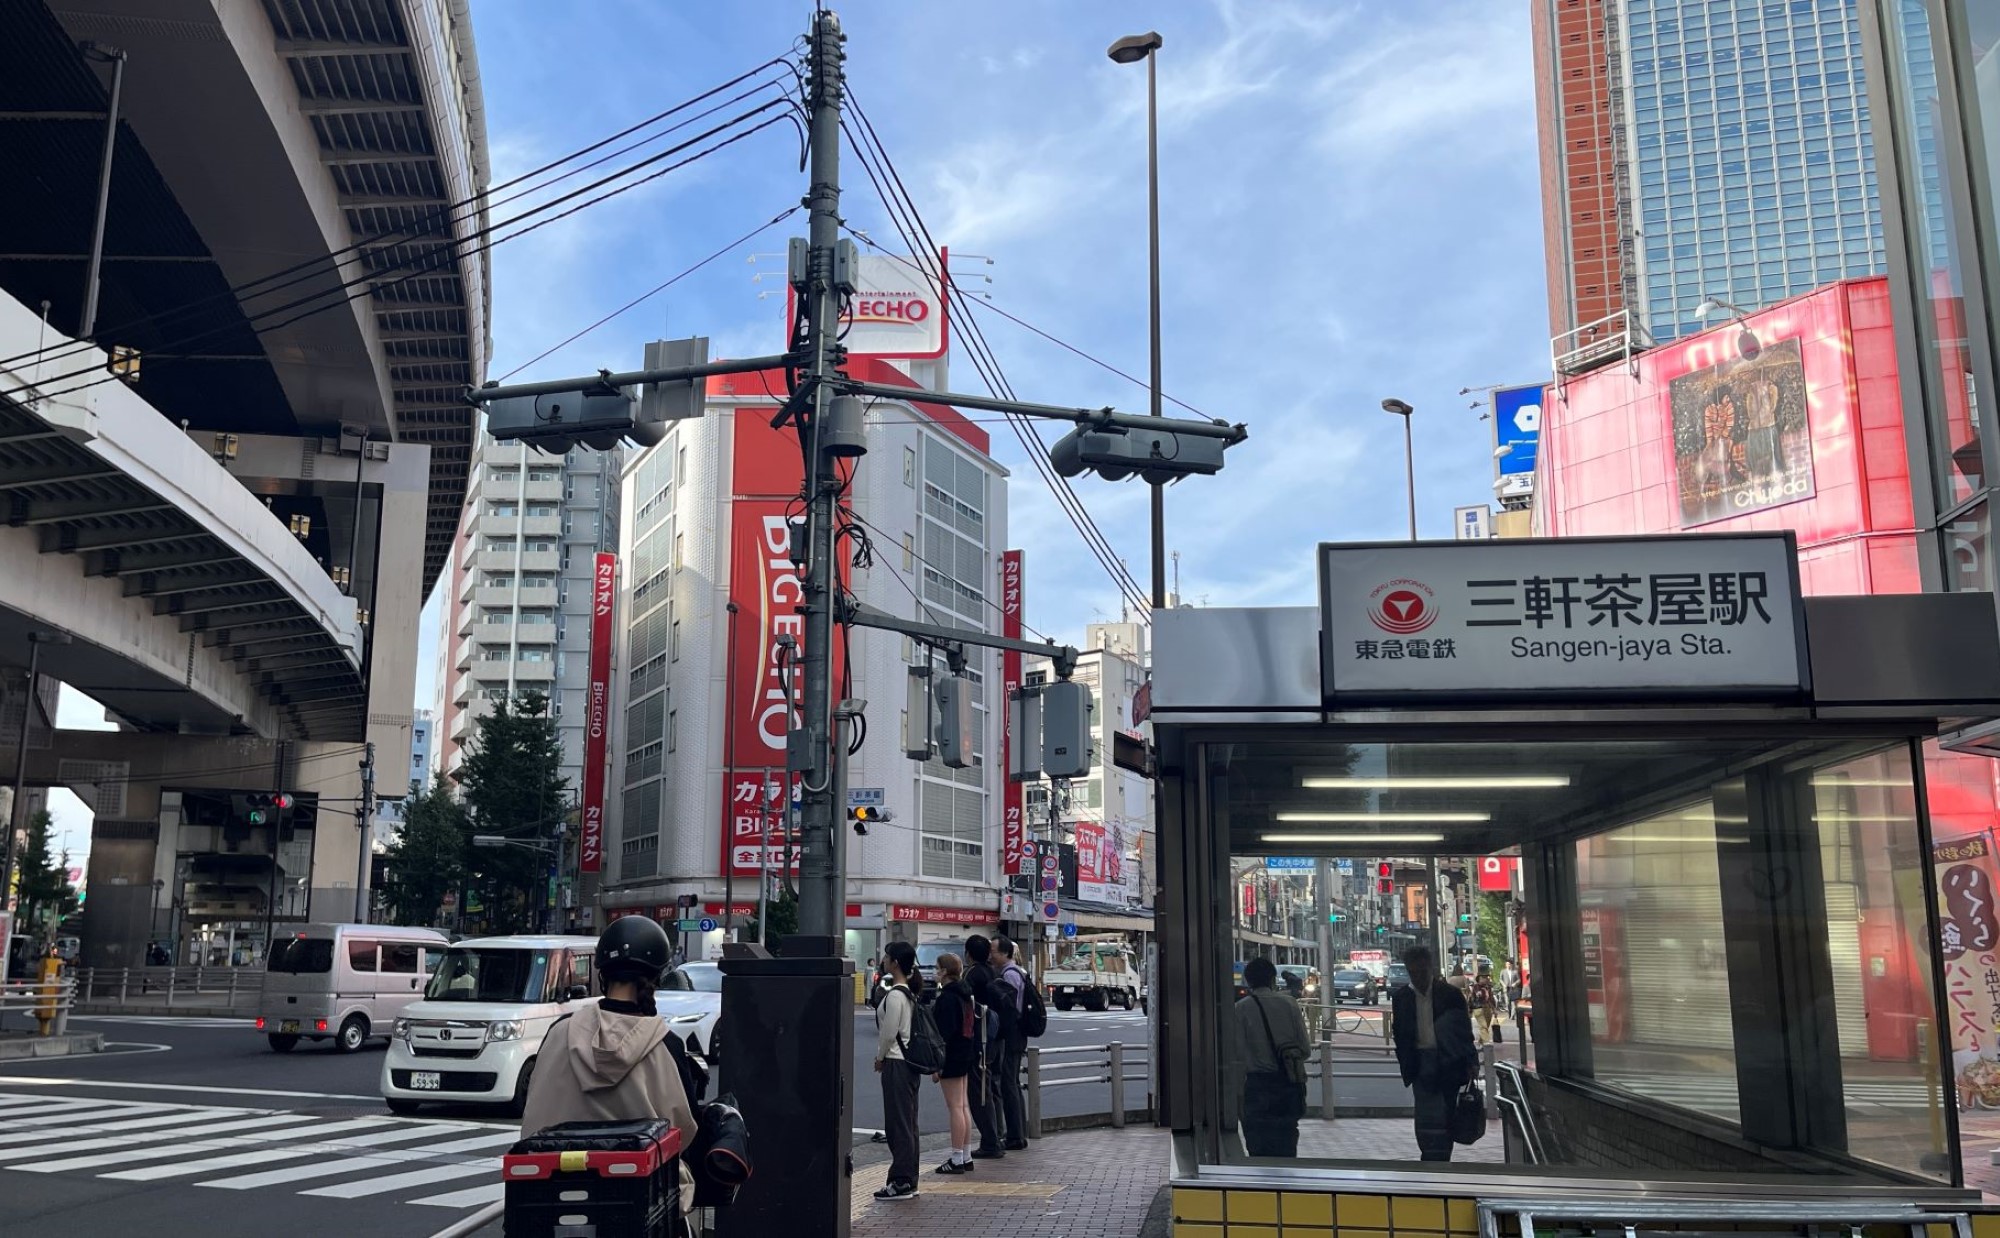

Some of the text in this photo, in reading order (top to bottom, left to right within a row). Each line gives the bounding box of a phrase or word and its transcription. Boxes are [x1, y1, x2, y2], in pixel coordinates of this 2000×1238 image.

[859, 299, 929, 321] ECHO
[596, 562, 613, 616] カラオケ
[1005, 561, 1019, 615] カラオケ
[1370, 578, 1434, 598] TOKYU CORPORATION
[1465, 572, 1772, 630] 三軒茶屋駅
[1355, 639, 1457, 660] 東急電鉄
[1510, 633, 1732, 662] Sangen-jaya Sta.
[583, 805, 600, 862] カラオケ
[1006, 807, 1020, 864] カラオケ
[702, 920, 710, 930] 3
[898, 908, 920, 919] カラオケ
